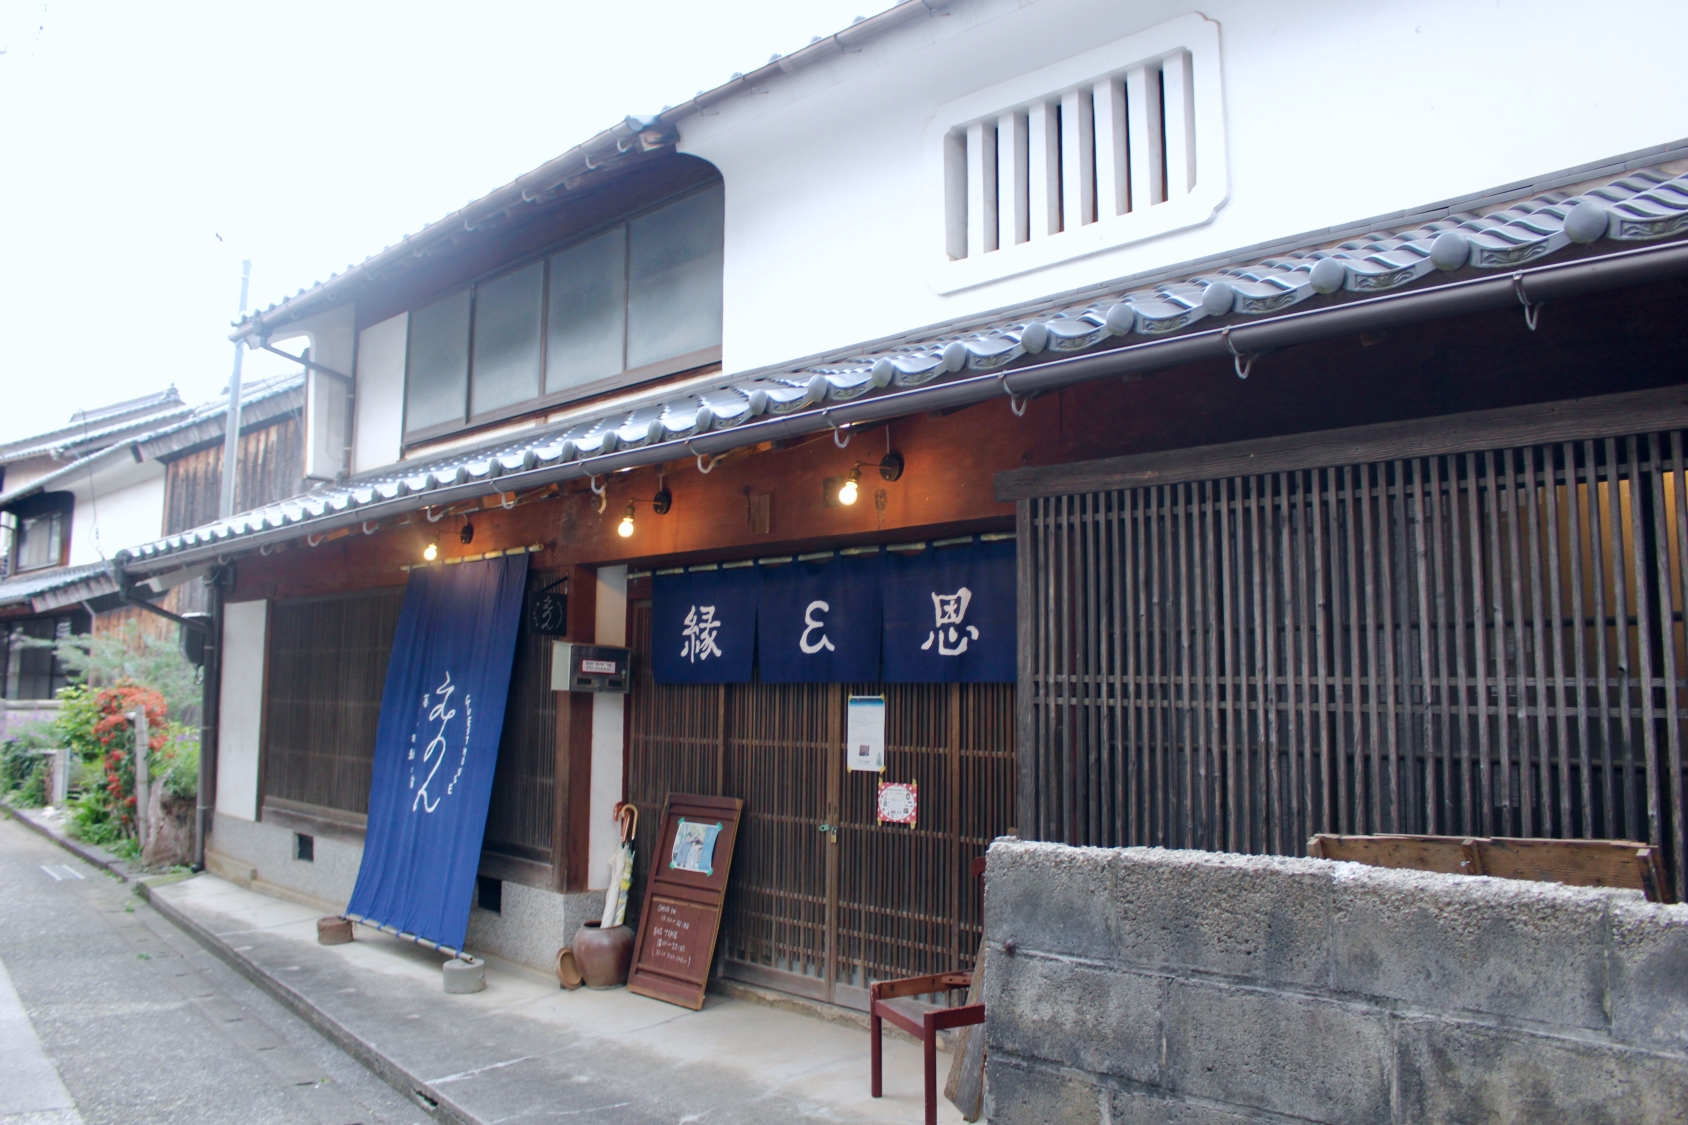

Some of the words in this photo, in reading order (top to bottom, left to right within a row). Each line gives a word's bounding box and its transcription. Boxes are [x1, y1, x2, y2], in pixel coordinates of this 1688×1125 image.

[680, 604, 722, 663] 縁
[464, 693, 472, 745] GUEST
[447, 746, 468, 796] HOUSE
[664, 929, 678, 939] TIME
